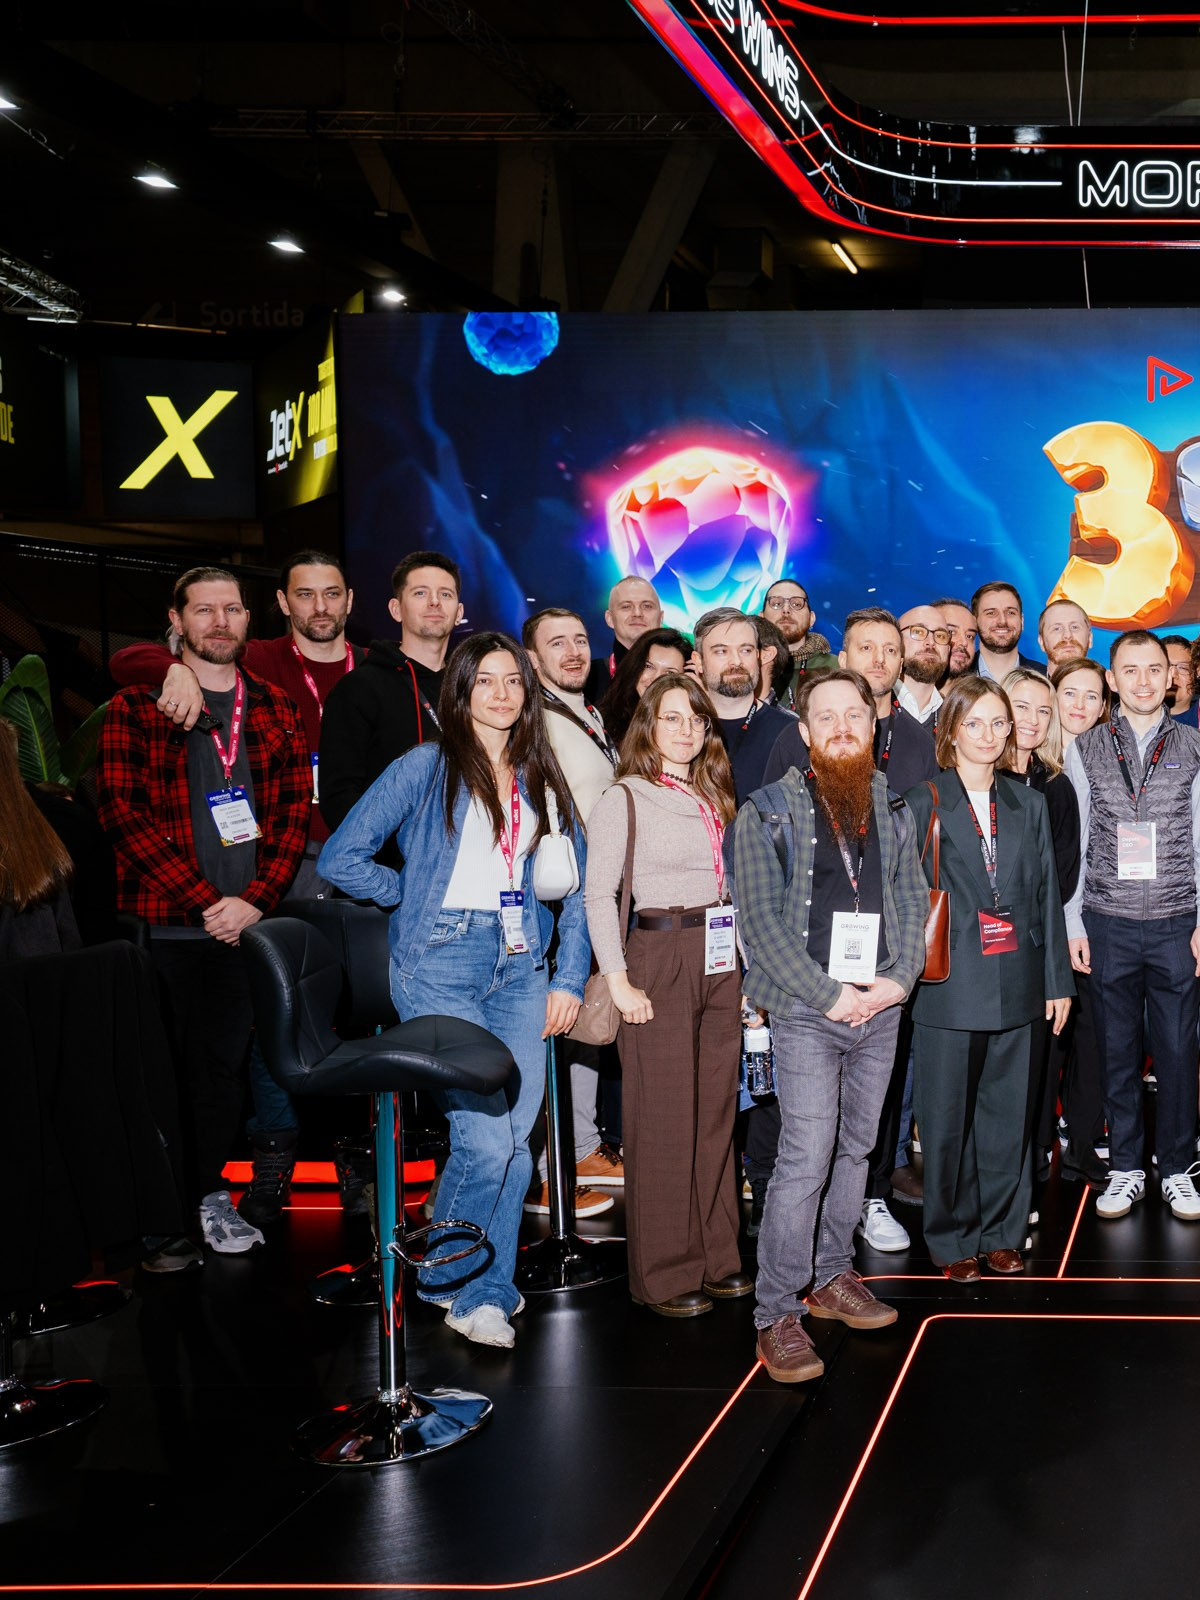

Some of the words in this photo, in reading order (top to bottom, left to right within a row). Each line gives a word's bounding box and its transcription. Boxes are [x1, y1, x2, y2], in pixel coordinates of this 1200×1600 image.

[739, 0, 799, 119] WINS
[200, 301, 305, 328] Sortida
[119, 390, 239, 489] X
[1042, 420, 1195, 632] 3
[1143, 764, 1154, 786] PLAYSON
[843, 851, 855, 877] PLAYSON
[981, 838, 990, 864] PLAYSON
[983, 927, 1013, 935] Compliance
